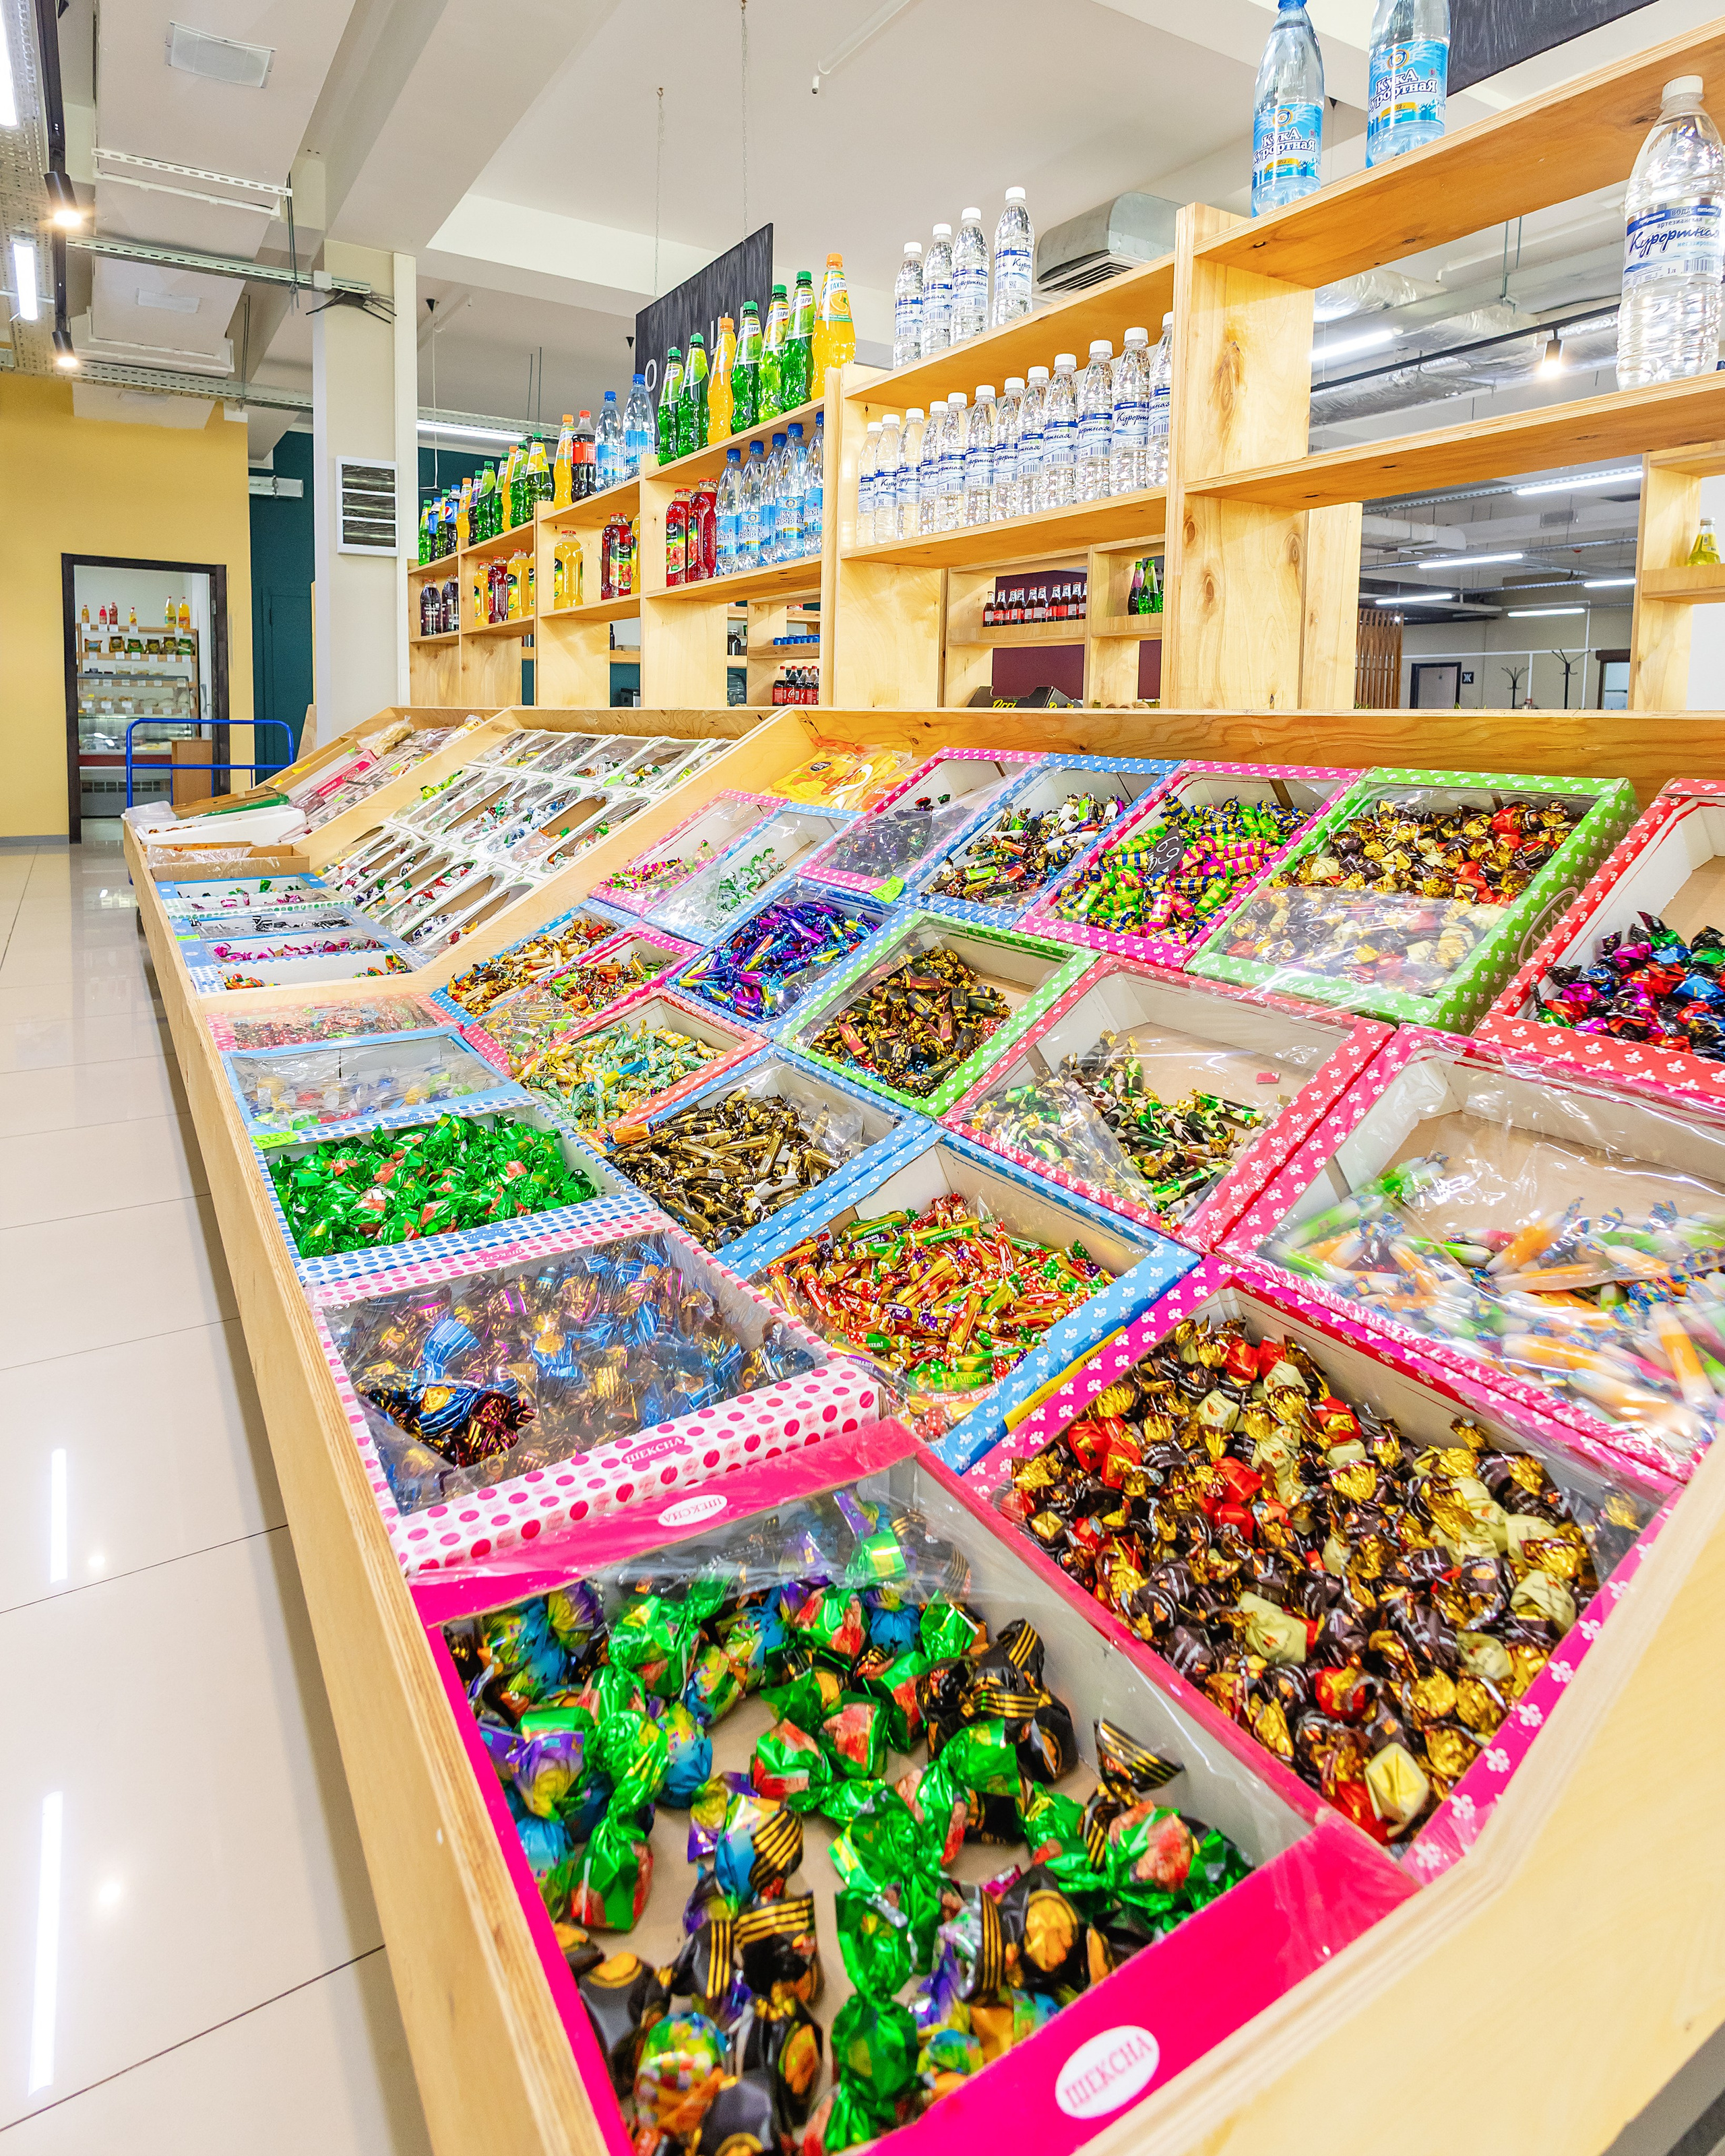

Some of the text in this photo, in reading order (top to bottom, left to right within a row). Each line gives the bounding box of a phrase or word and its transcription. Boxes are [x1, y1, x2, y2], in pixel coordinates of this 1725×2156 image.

[479, 1248, 522, 1262] ШЕКСНА
[947, 1376, 981, 1384] MOMENT
[626, 1436, 683, 1464] ШЕКСНА
[663, 1498, 722, 1523] ШЕКСНА
[1064, 2035, 1152, 2109] ШЕКСНА
